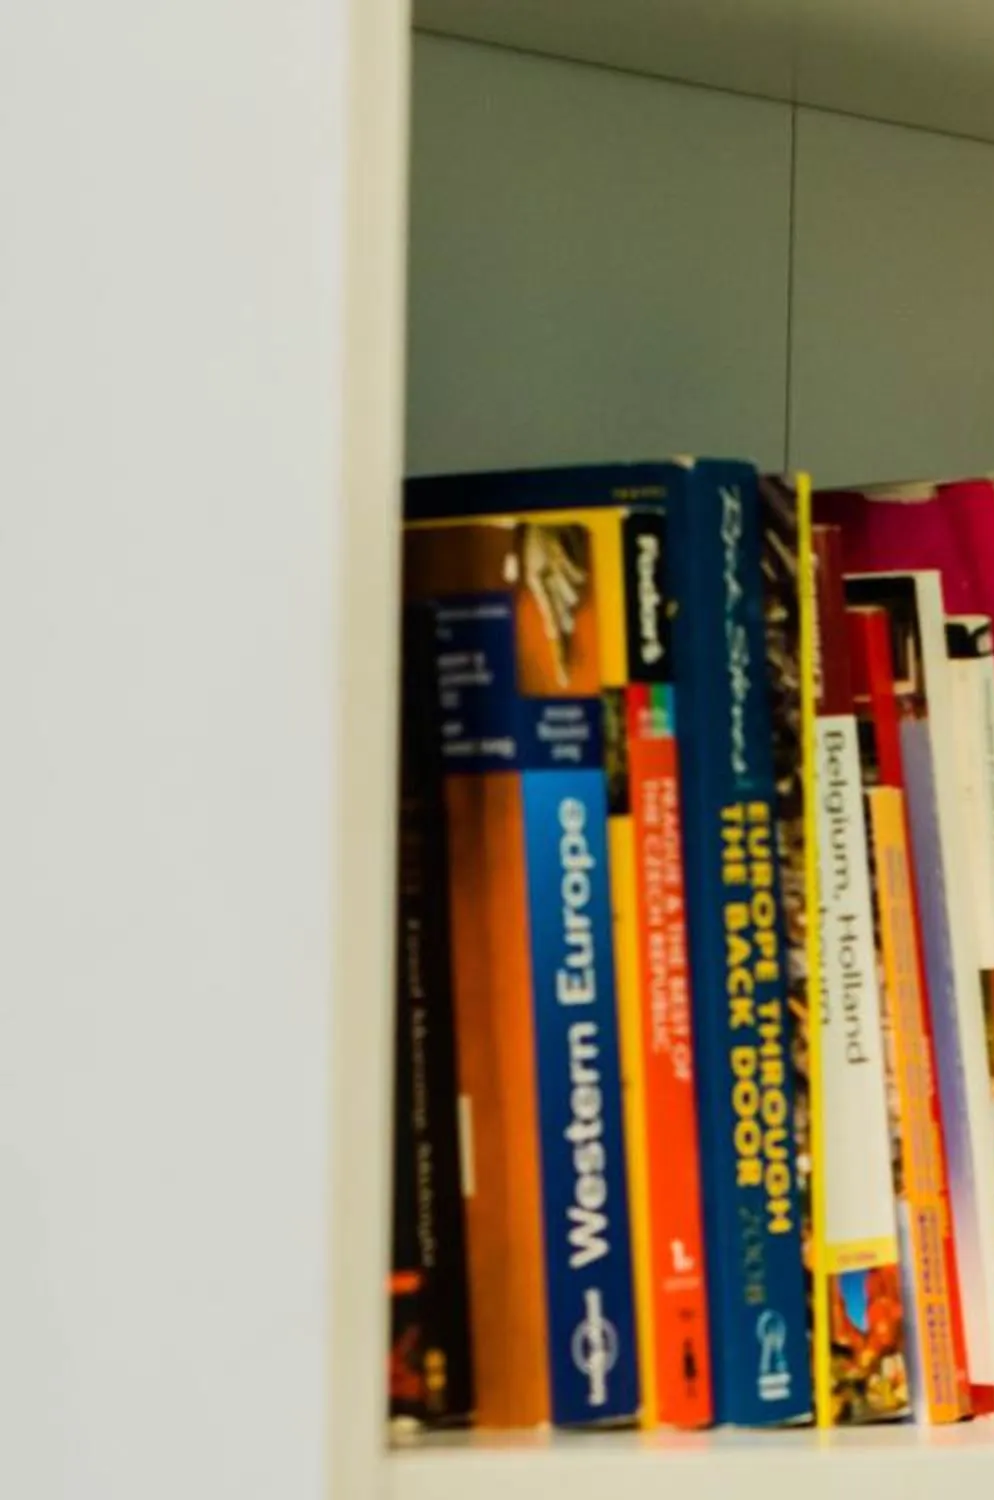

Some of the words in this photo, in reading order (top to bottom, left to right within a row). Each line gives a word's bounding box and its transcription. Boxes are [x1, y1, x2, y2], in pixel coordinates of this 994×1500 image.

[643, 779, 660, 826] THE
[720, 806, 748, 885] THE
[822, 729, 853, 900] Belgium,
[555, 798, 598, 1005] Europe
[644, 833, 665, 927] CZECH
[747, 801, 780, 982] EUROPE
[649, 932, 670, 1056] REPUBLIC
[724, 903, 756, 1030] BACK
[837, 913, 872, 1067] Holland
[563, 1022, 610, 1269] Western
[729, 1046, 763, 1189] DOOR
[757, 1001, 794, 1235] THROUGH
